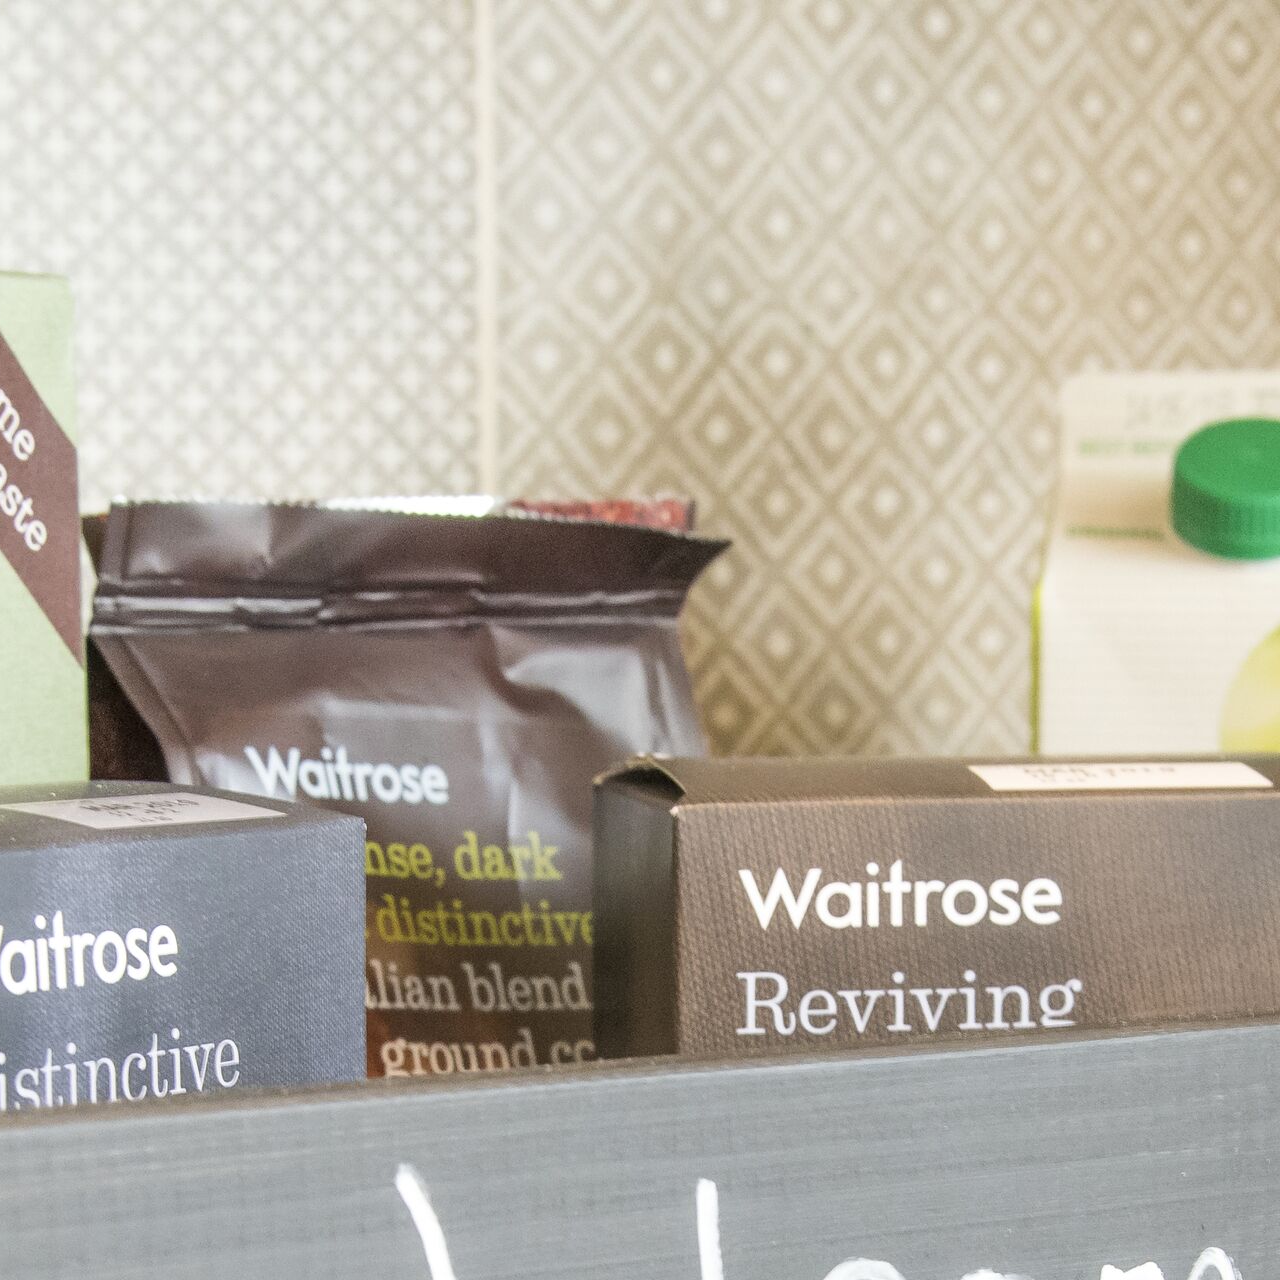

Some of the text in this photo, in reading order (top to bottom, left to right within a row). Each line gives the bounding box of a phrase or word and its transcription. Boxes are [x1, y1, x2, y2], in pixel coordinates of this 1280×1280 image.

[242, 744, 449, 804] Waitrose
[454, 829, 563, 881] dark
[737, 859, 1063, 931] Waitrose
[461, 961, 593, 1011] blend
[736, 970, 1083, 1037] Reviving
[381, 1028, 538, 1078] ground
